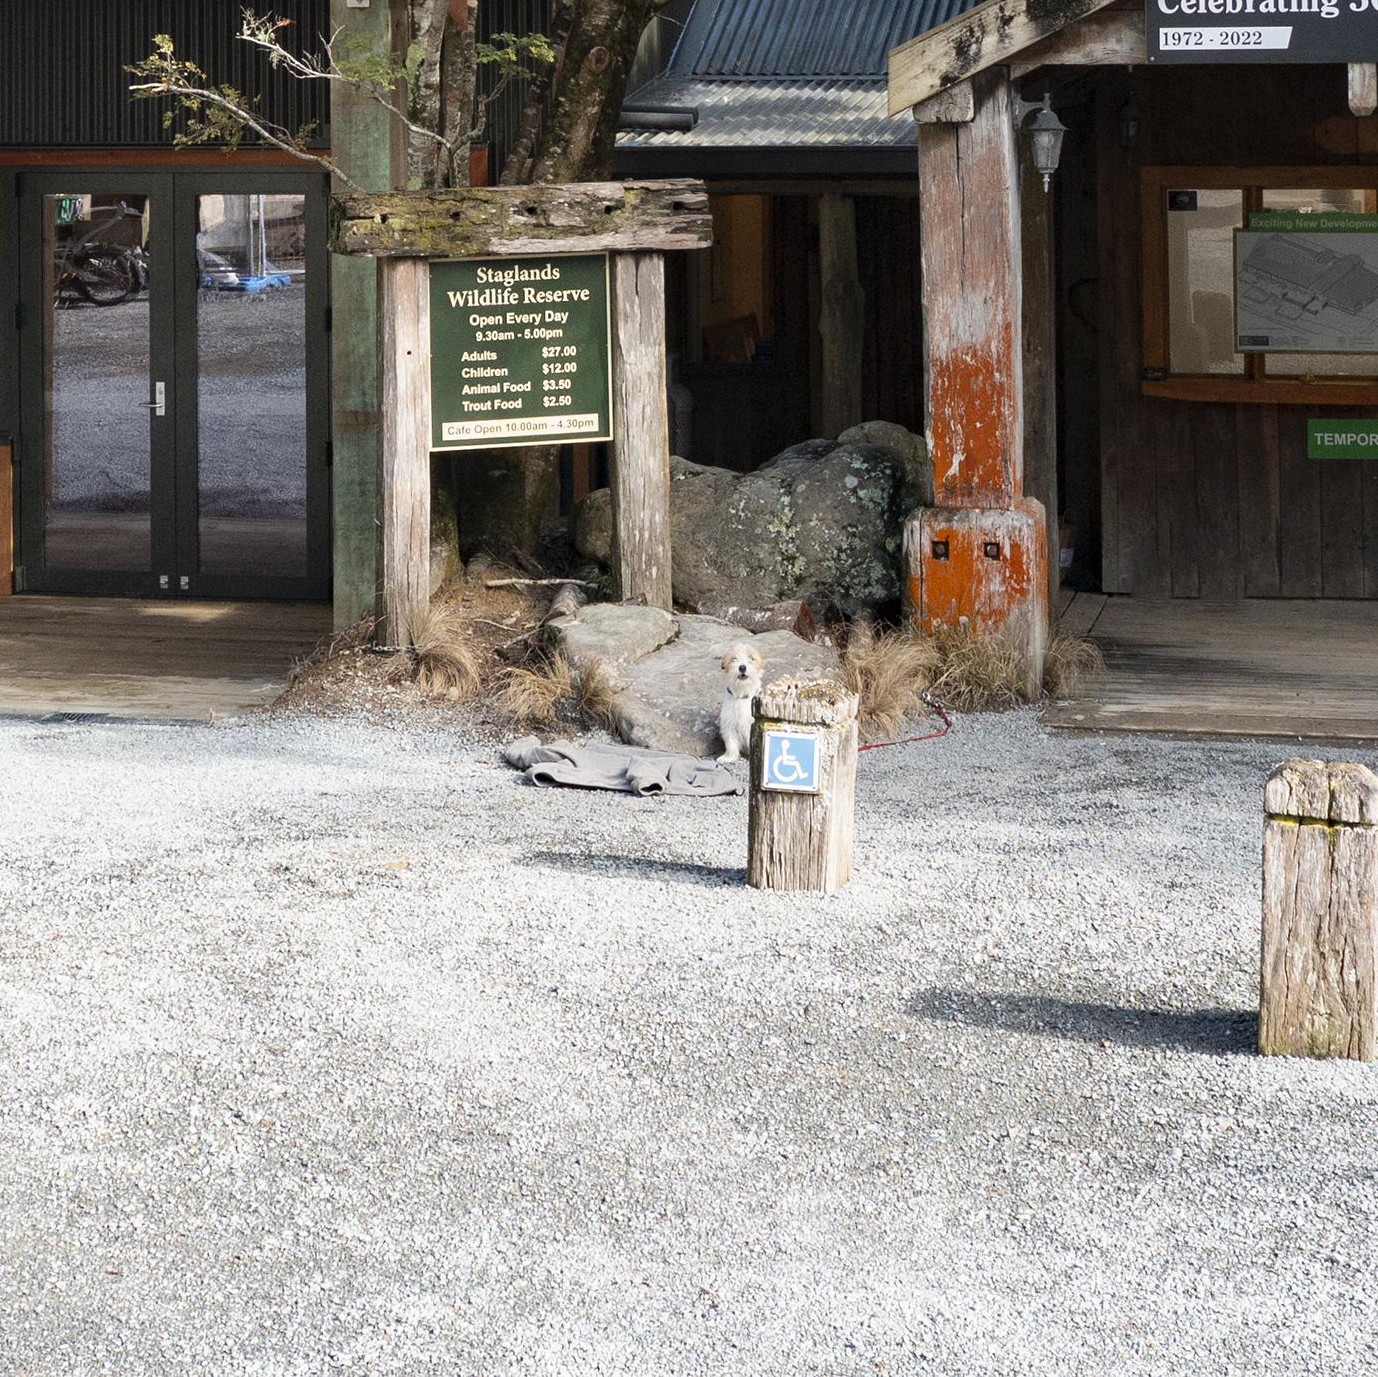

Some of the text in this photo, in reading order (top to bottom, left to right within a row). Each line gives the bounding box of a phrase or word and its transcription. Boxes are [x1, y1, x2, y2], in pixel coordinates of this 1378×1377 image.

[1162, 30, 1203, 46] 1972
[1219, 30, 1263, 46] 2022
[1251, 218, 1293, 230] Exciting
[1296, 218, 1318, 228] New
[477, 263, 561, 287] Staglands
[447, 287, 590, 308] Wildlife Reserve
[469, 310, 569, 327] Open Every Day
[475, 330, 515, 341] 9.30am
[524, 328, 563, 340] 5.00pm
[461, 345, 577, 362] Adults $27.00
[462, 362, 577, 378] Children $12.00
[461, 379, 571, 395] Animal Food $3.50
[462, 395, 572, 412] Trout Food $2.50
[447, 425, 471, 435] Cafe
[474, 424, 502, 435] Open
[505, 421, 548, 432] 10.00am
[557, 418, 594, 430] 4.30pm
